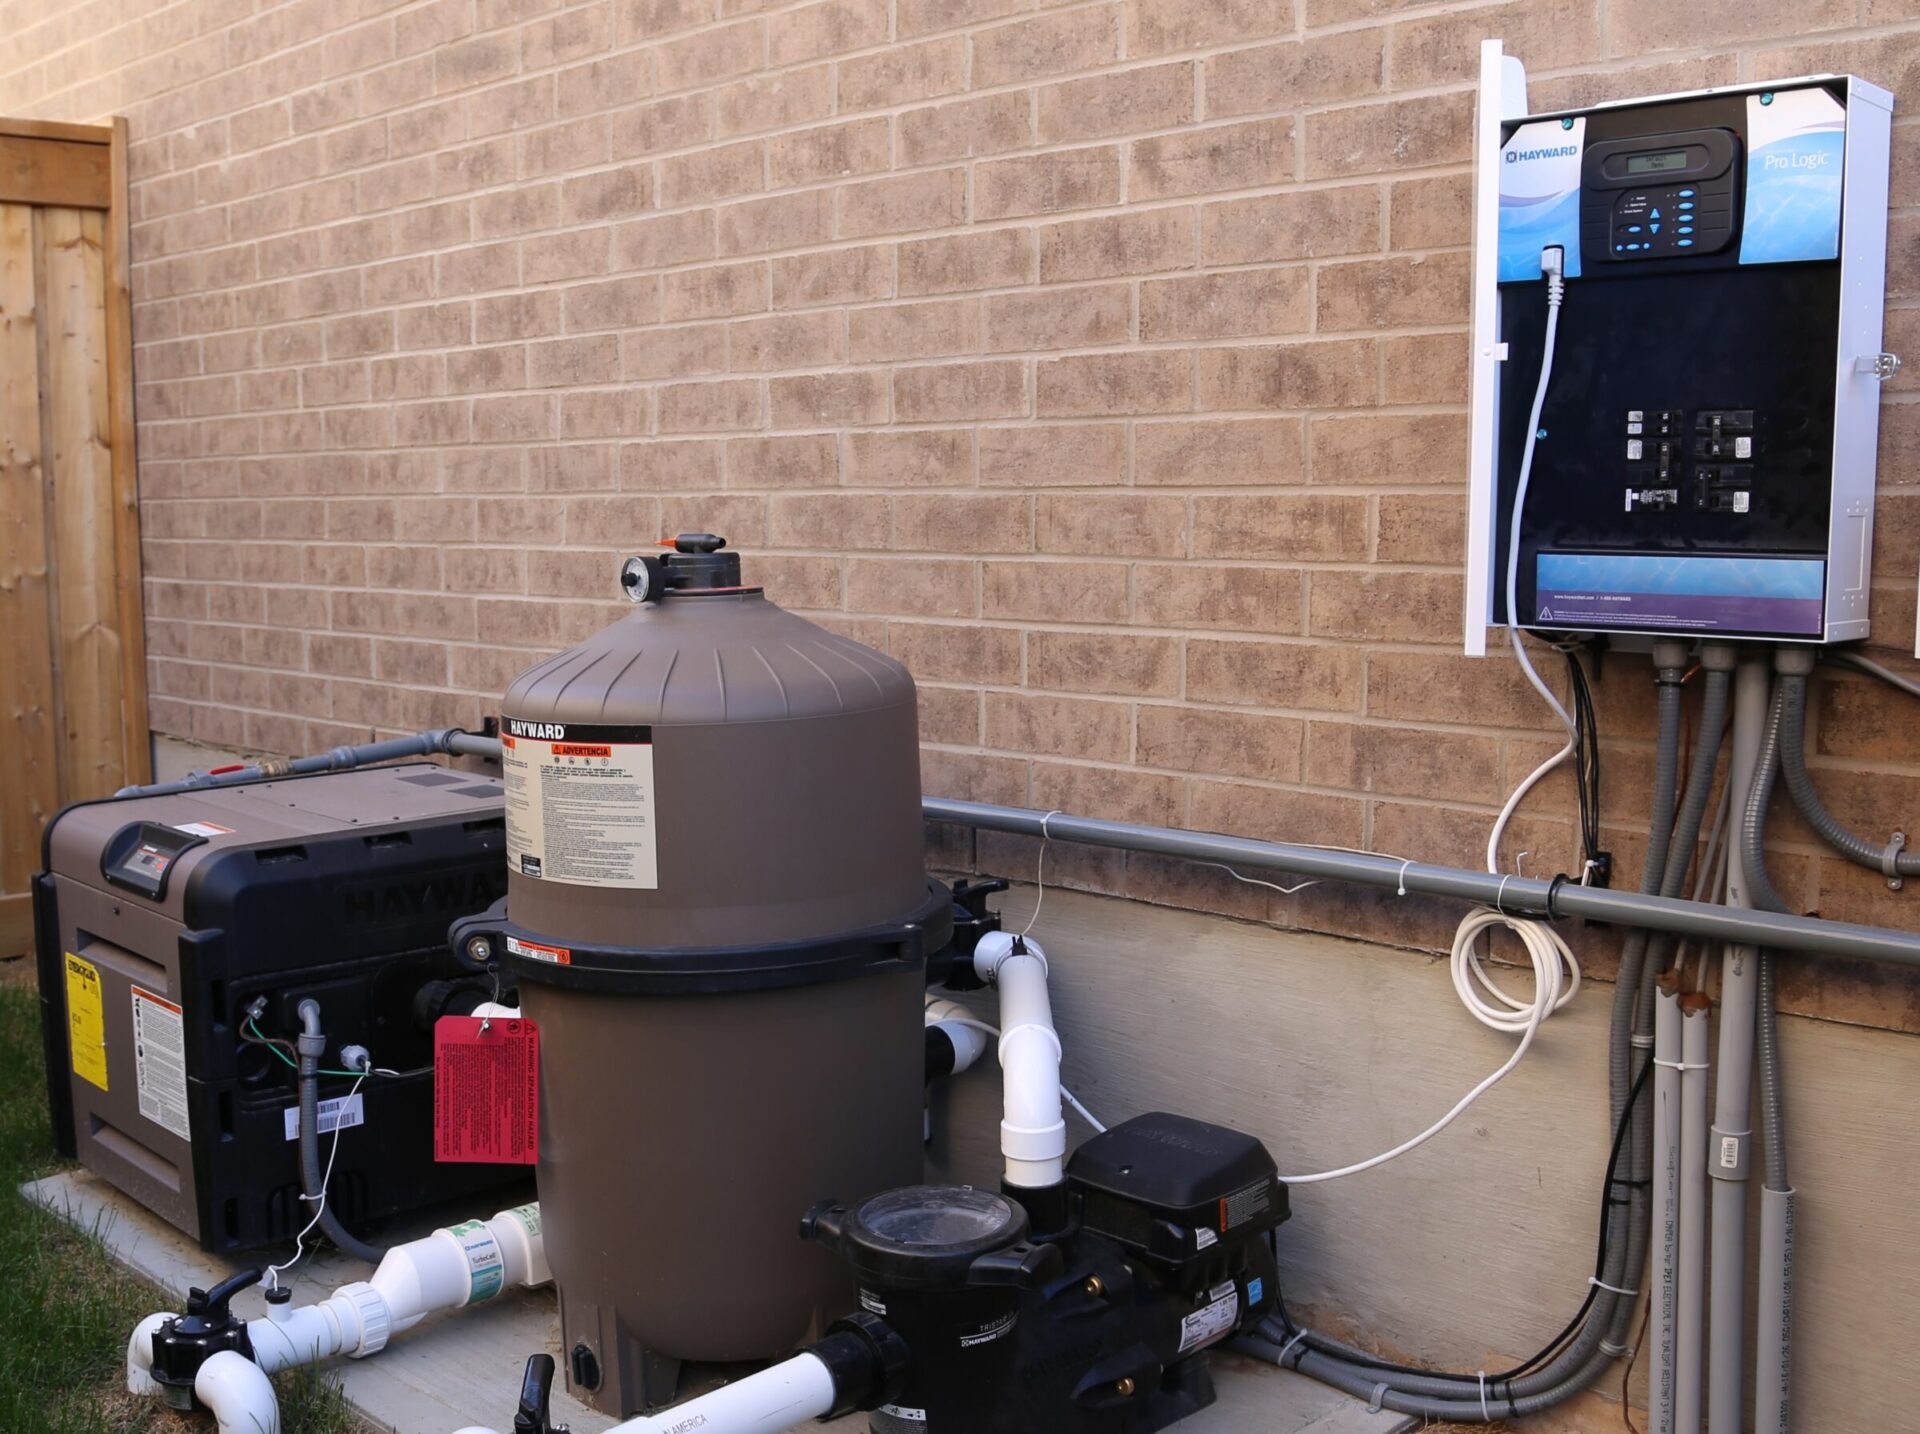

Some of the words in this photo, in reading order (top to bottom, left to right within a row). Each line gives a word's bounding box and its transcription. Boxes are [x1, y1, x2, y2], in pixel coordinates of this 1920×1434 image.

[1519, 146, 1577, 161] HAYWARD
[1764, 154, 1788, 170] Pro
[1792, 150, 1832, 170] Logic
[510, 719, 565, 740] HAYWARD
[563, 745, 608, 756] ADVERTENCIA
[527, 1037, 535, 1073] WARNING
[527, 1075, 535, 1119] SEPARATION
[527, 1121, 535, 1150] HAZARD
[968, 1333, 997, 1346] HAYWARD
[672, 1414, 709, 1434] AMERICA
